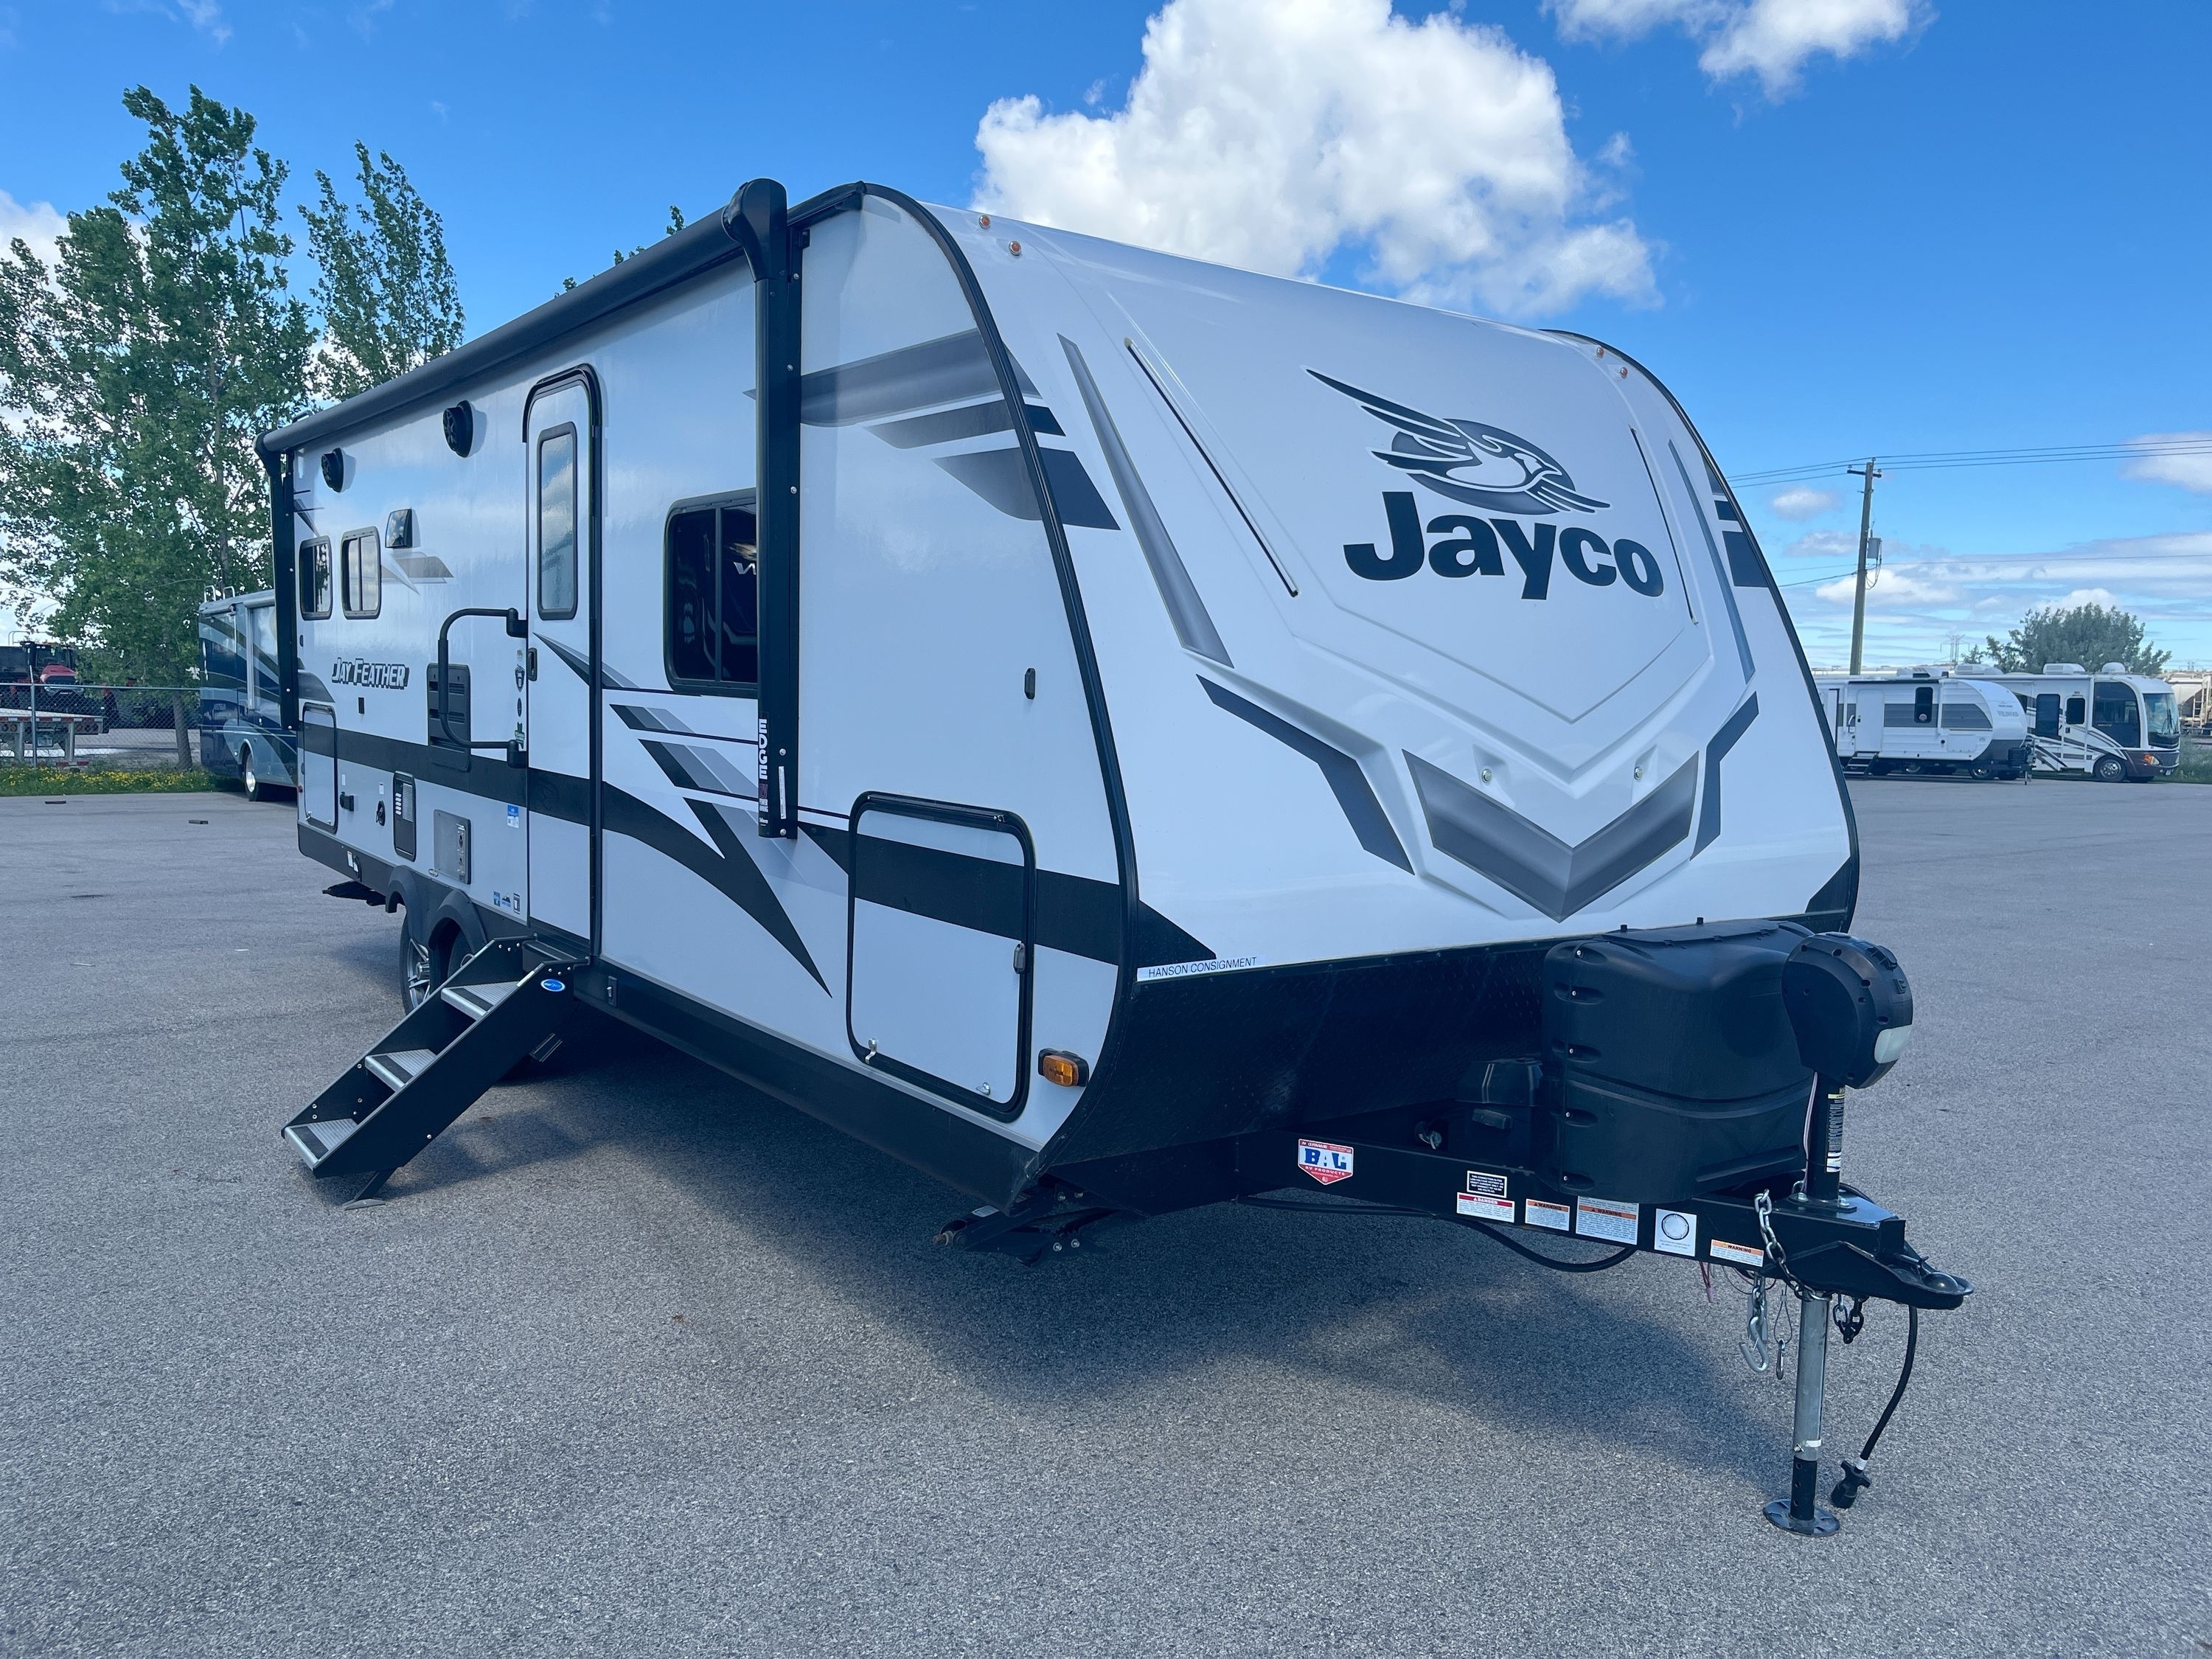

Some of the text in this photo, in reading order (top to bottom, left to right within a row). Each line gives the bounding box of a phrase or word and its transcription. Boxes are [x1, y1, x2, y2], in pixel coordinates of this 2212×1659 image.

[1343, 492, 1663, 600] Jayco
[332, 657, 408, 689] JAY FEATHER
[759, 719, 768, 779] EDGE
[1149, 957, 1256, 978] HANSON CONSIGNMENT
[1305, 1148, 1346, 1169] BAL
[1315, 1167, 1345, 1175] PRODUCTS
[1539, 1203, 1562, 1211] WARNING
[1598, 1208, 1622, 1217] WARNING
[1728, 1245, 1752, 1253] WARNING
